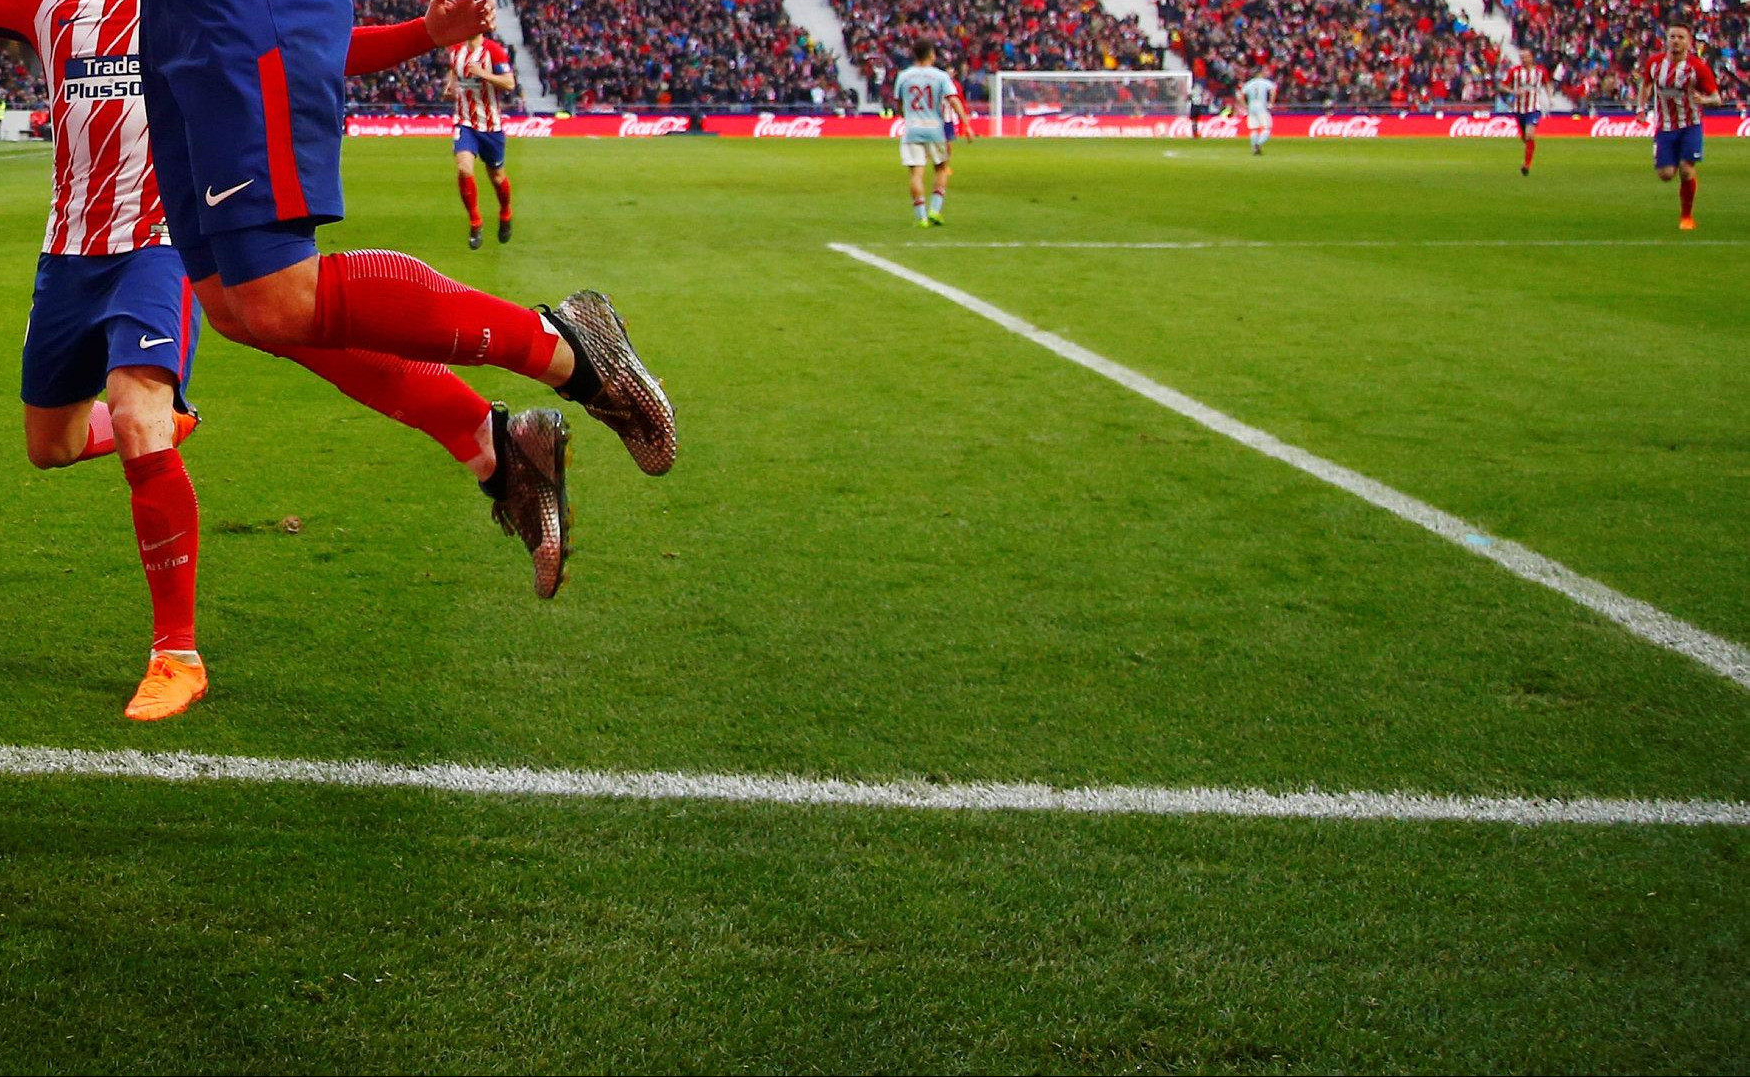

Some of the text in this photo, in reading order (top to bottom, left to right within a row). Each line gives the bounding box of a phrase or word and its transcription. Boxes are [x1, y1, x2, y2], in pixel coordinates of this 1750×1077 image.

[83, 57, 140, 76] Trade
[66, 81, 143, 101] Plus50
[909, 84, 934, 111] 21
[755, 112, 825, 137] Coca-Cola
[1310, 115, 1383, 137] Coca-Cola
